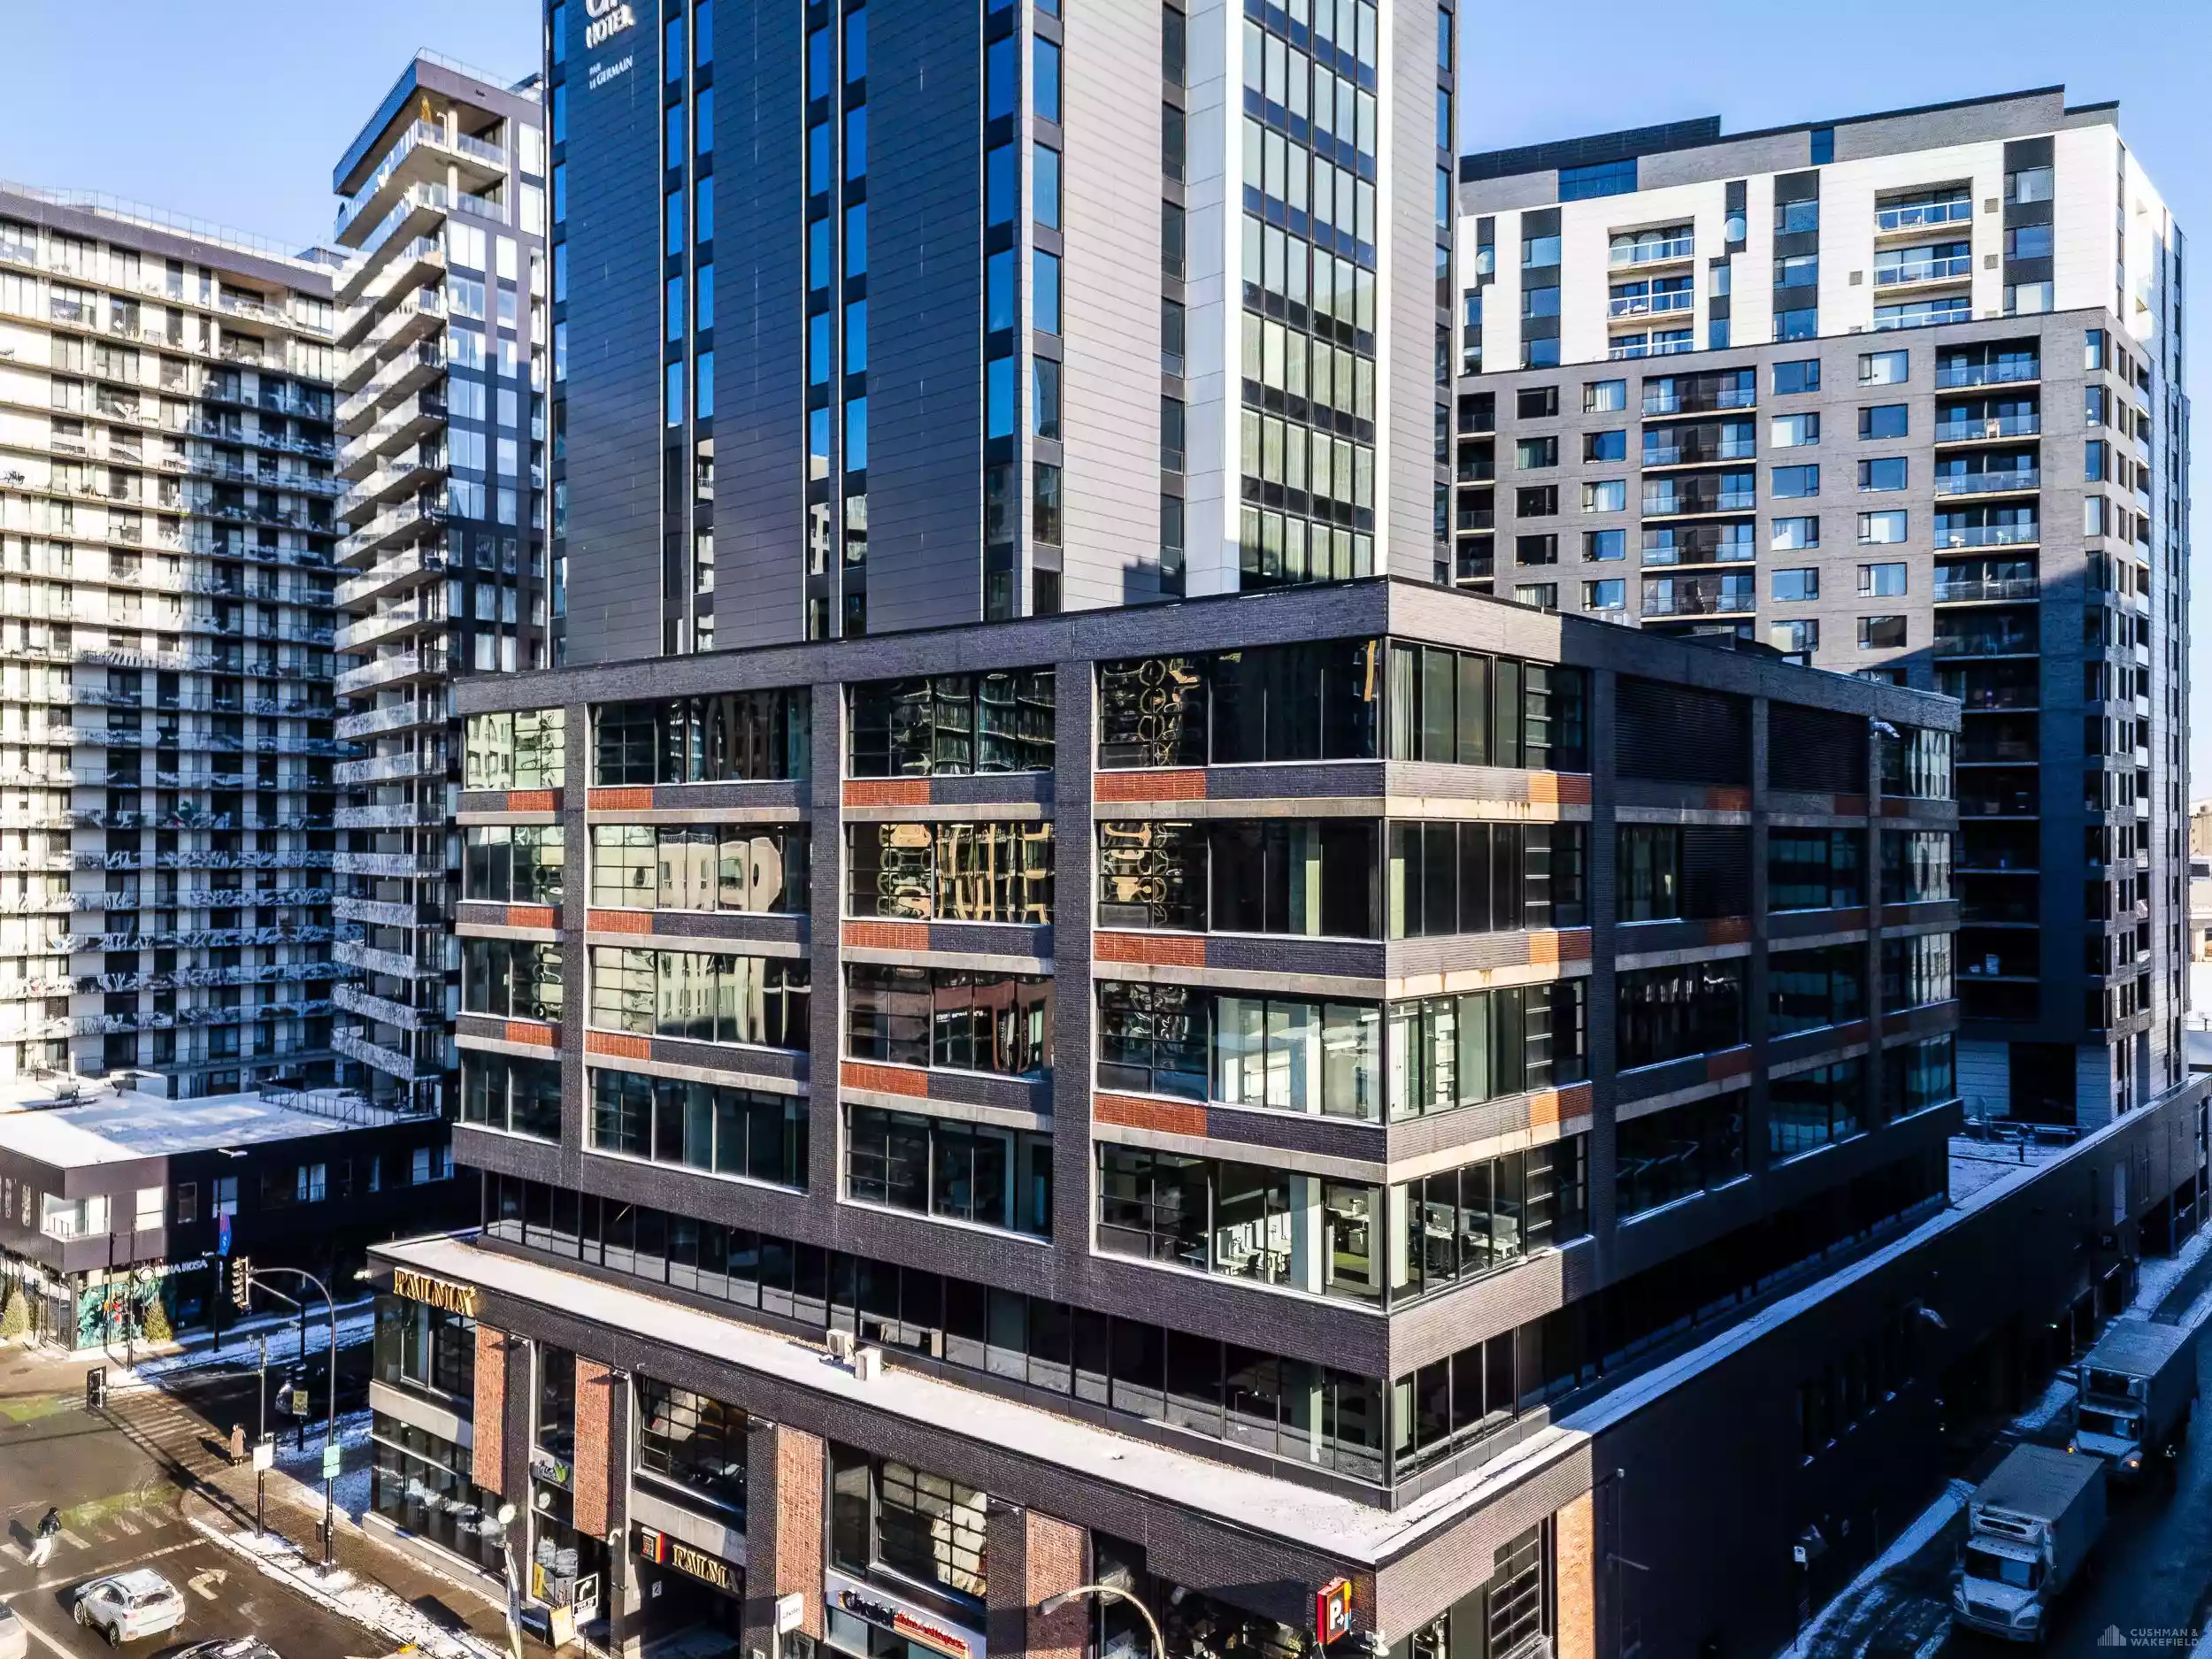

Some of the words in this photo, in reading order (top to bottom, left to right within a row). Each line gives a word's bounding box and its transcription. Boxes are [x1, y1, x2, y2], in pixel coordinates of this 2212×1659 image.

[586, 4, 636, 49] HOTEL
[393, 1266, 475, 1317] PALMA
[672, 1543, 741, 1594] PALMA
